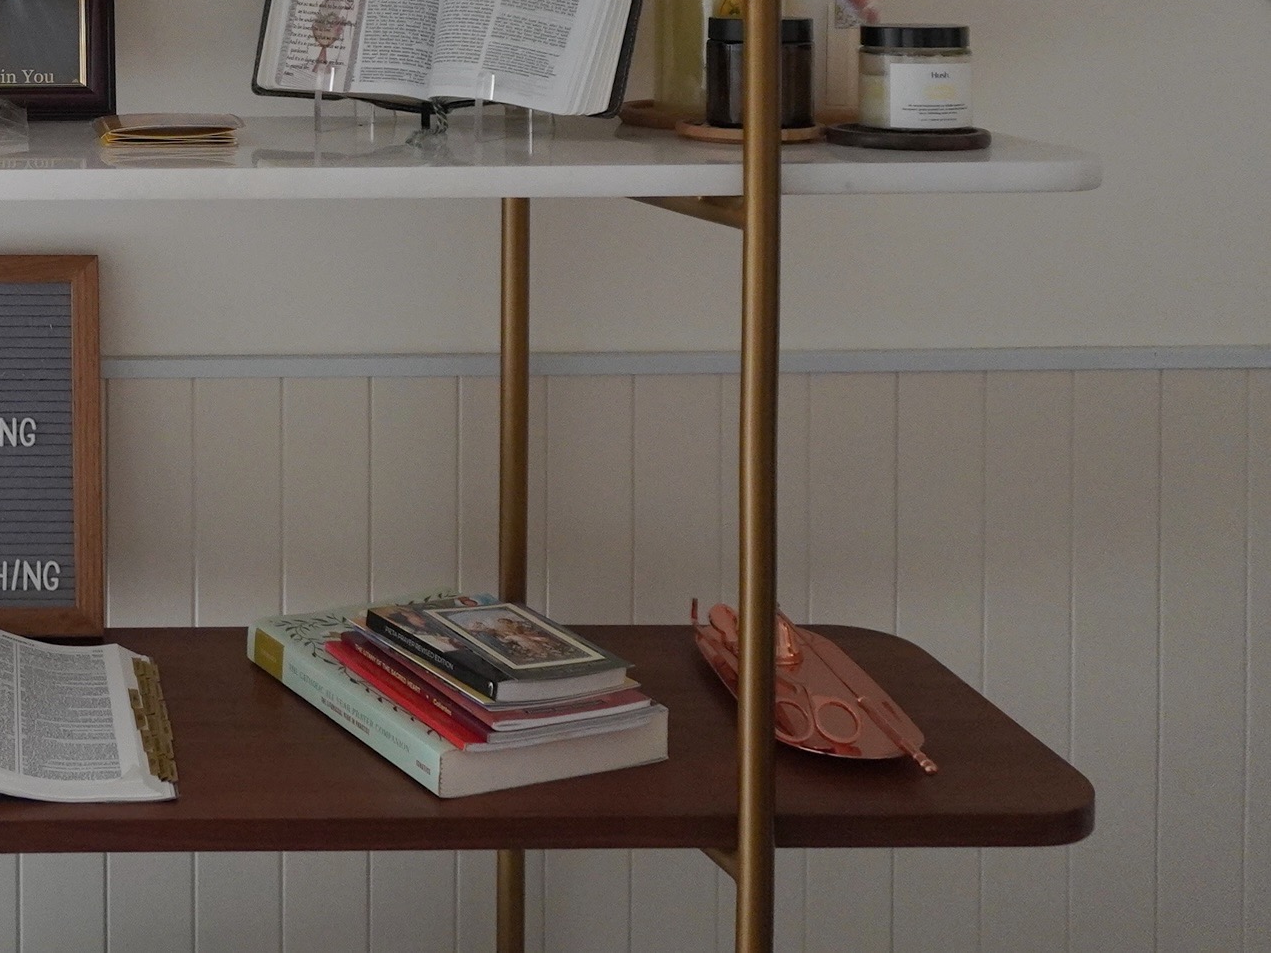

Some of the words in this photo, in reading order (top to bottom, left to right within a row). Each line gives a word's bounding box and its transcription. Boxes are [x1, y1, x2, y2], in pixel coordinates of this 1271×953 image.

[0, 69, 17, 84] in
[22, 69, 55, 84] You
[397, 633, 415, 646] PRAYER
[415, 641, 434, 658] REVISED
[434, 652, 454, 670] EDITION
[390, 668, 407, 685] SACRED
[406, 680, 421, 694] HEART
[351, 707, 374, 727] PRAYER
[375, 723, 410, 752] COMPANION
